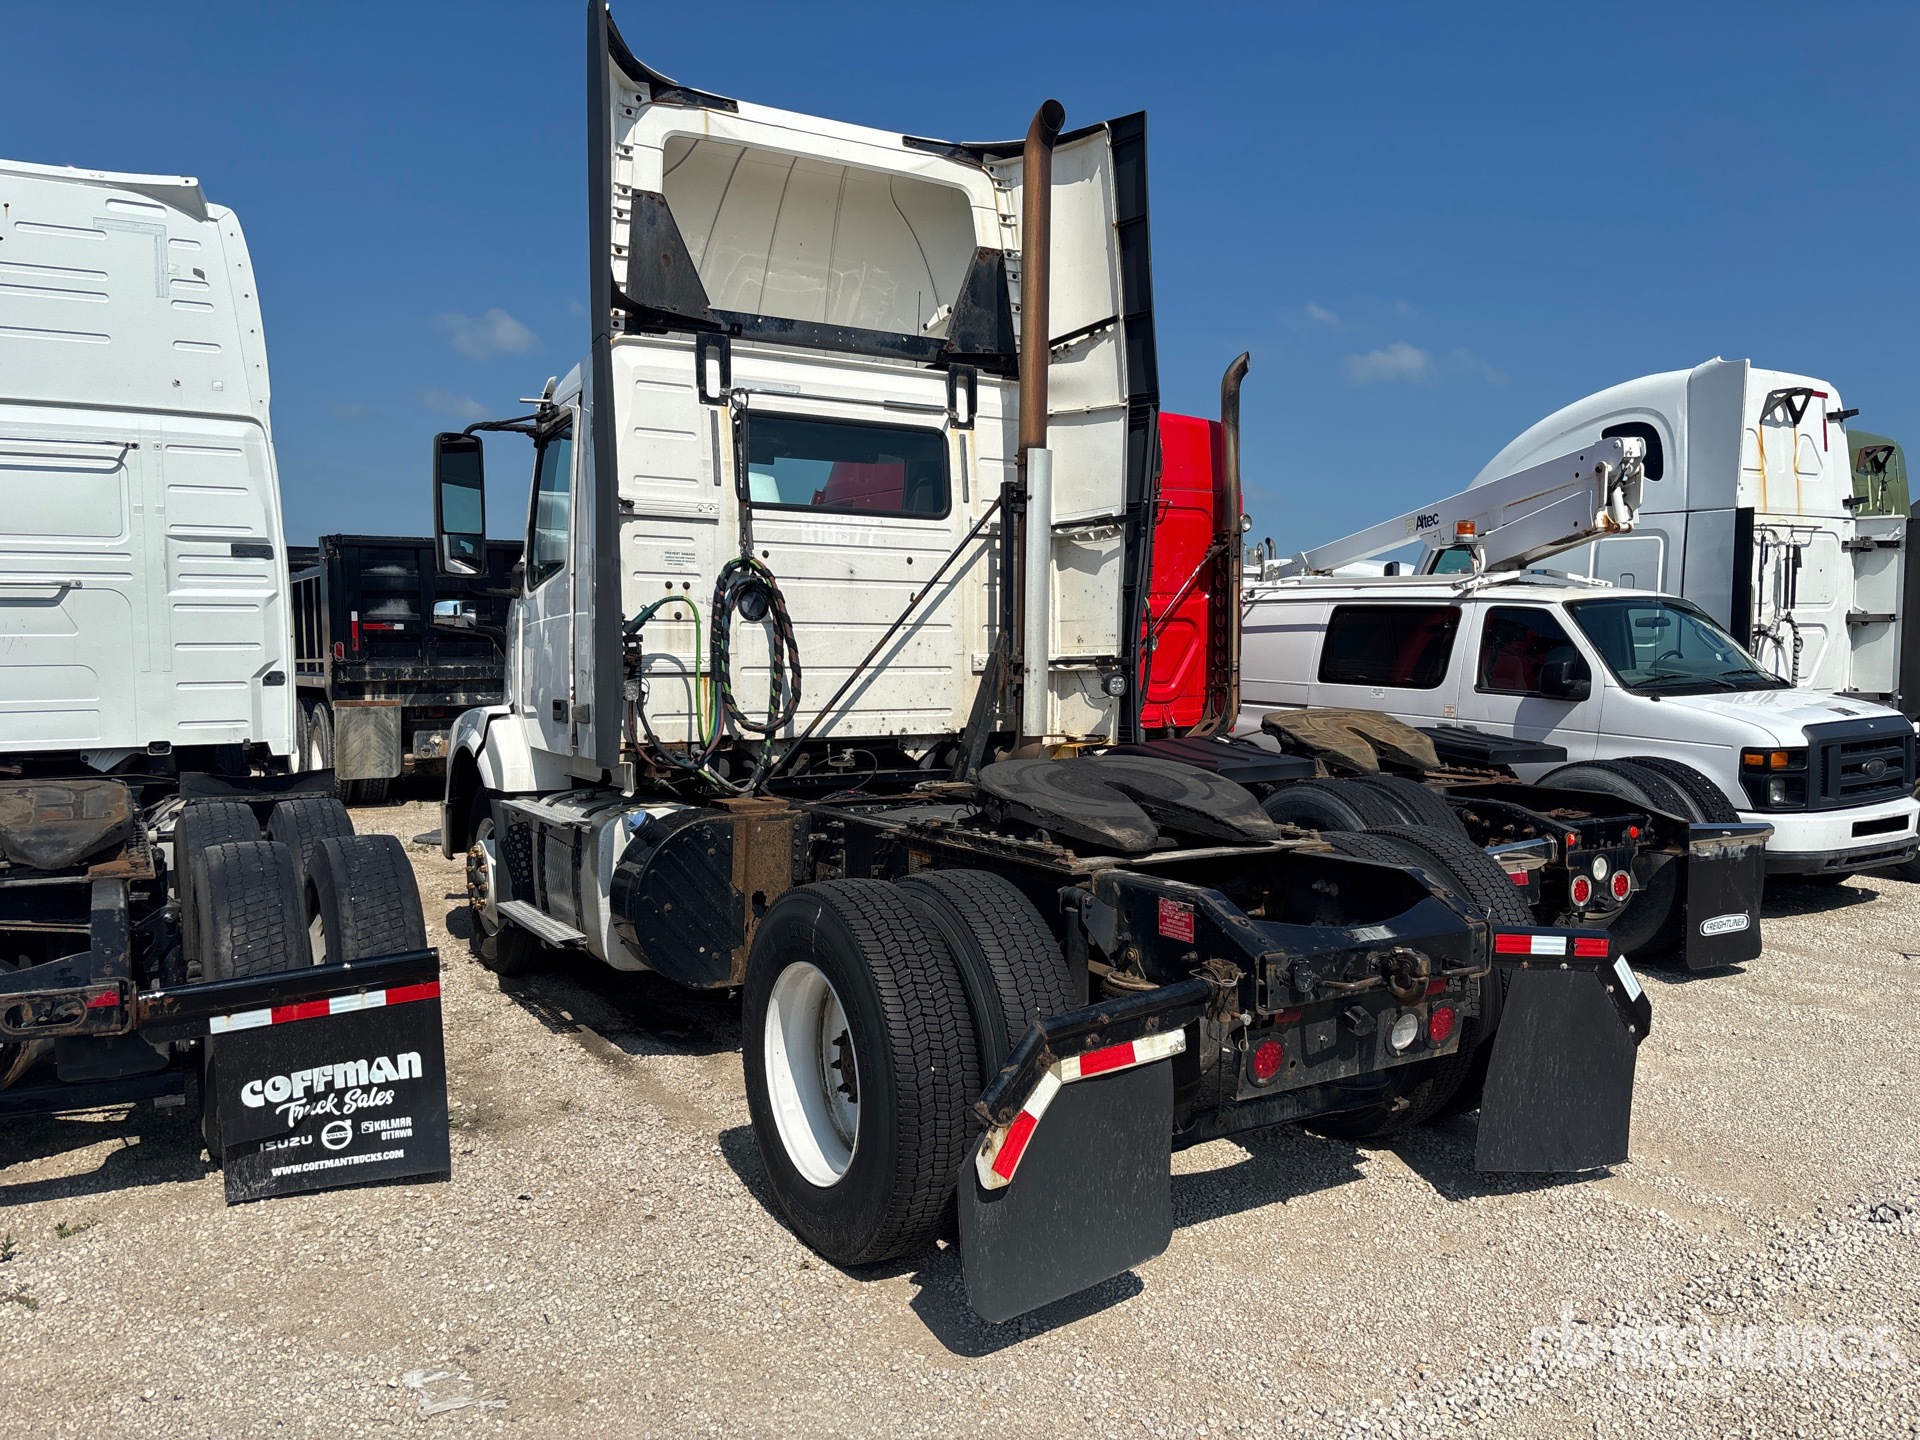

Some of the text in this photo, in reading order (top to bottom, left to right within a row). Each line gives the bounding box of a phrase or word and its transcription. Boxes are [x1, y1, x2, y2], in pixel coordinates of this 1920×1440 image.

[1416, 513, 1439, 531] Altec
[1706, 918, 1745, 931] FREIGHTLINER
[241, 1052, 422, 1107] COFFMAN
[276, 1087, 394, 1127] Truck Sales
[374, 1117, 412, 1131] KALMAR
[381, 1128, 412, 1140] OTTAWA
[260, 1135, 312, 1152] ISUZU
[271, 1149, 404, 1176] WWW.COFFMANTRUCKS.COM
